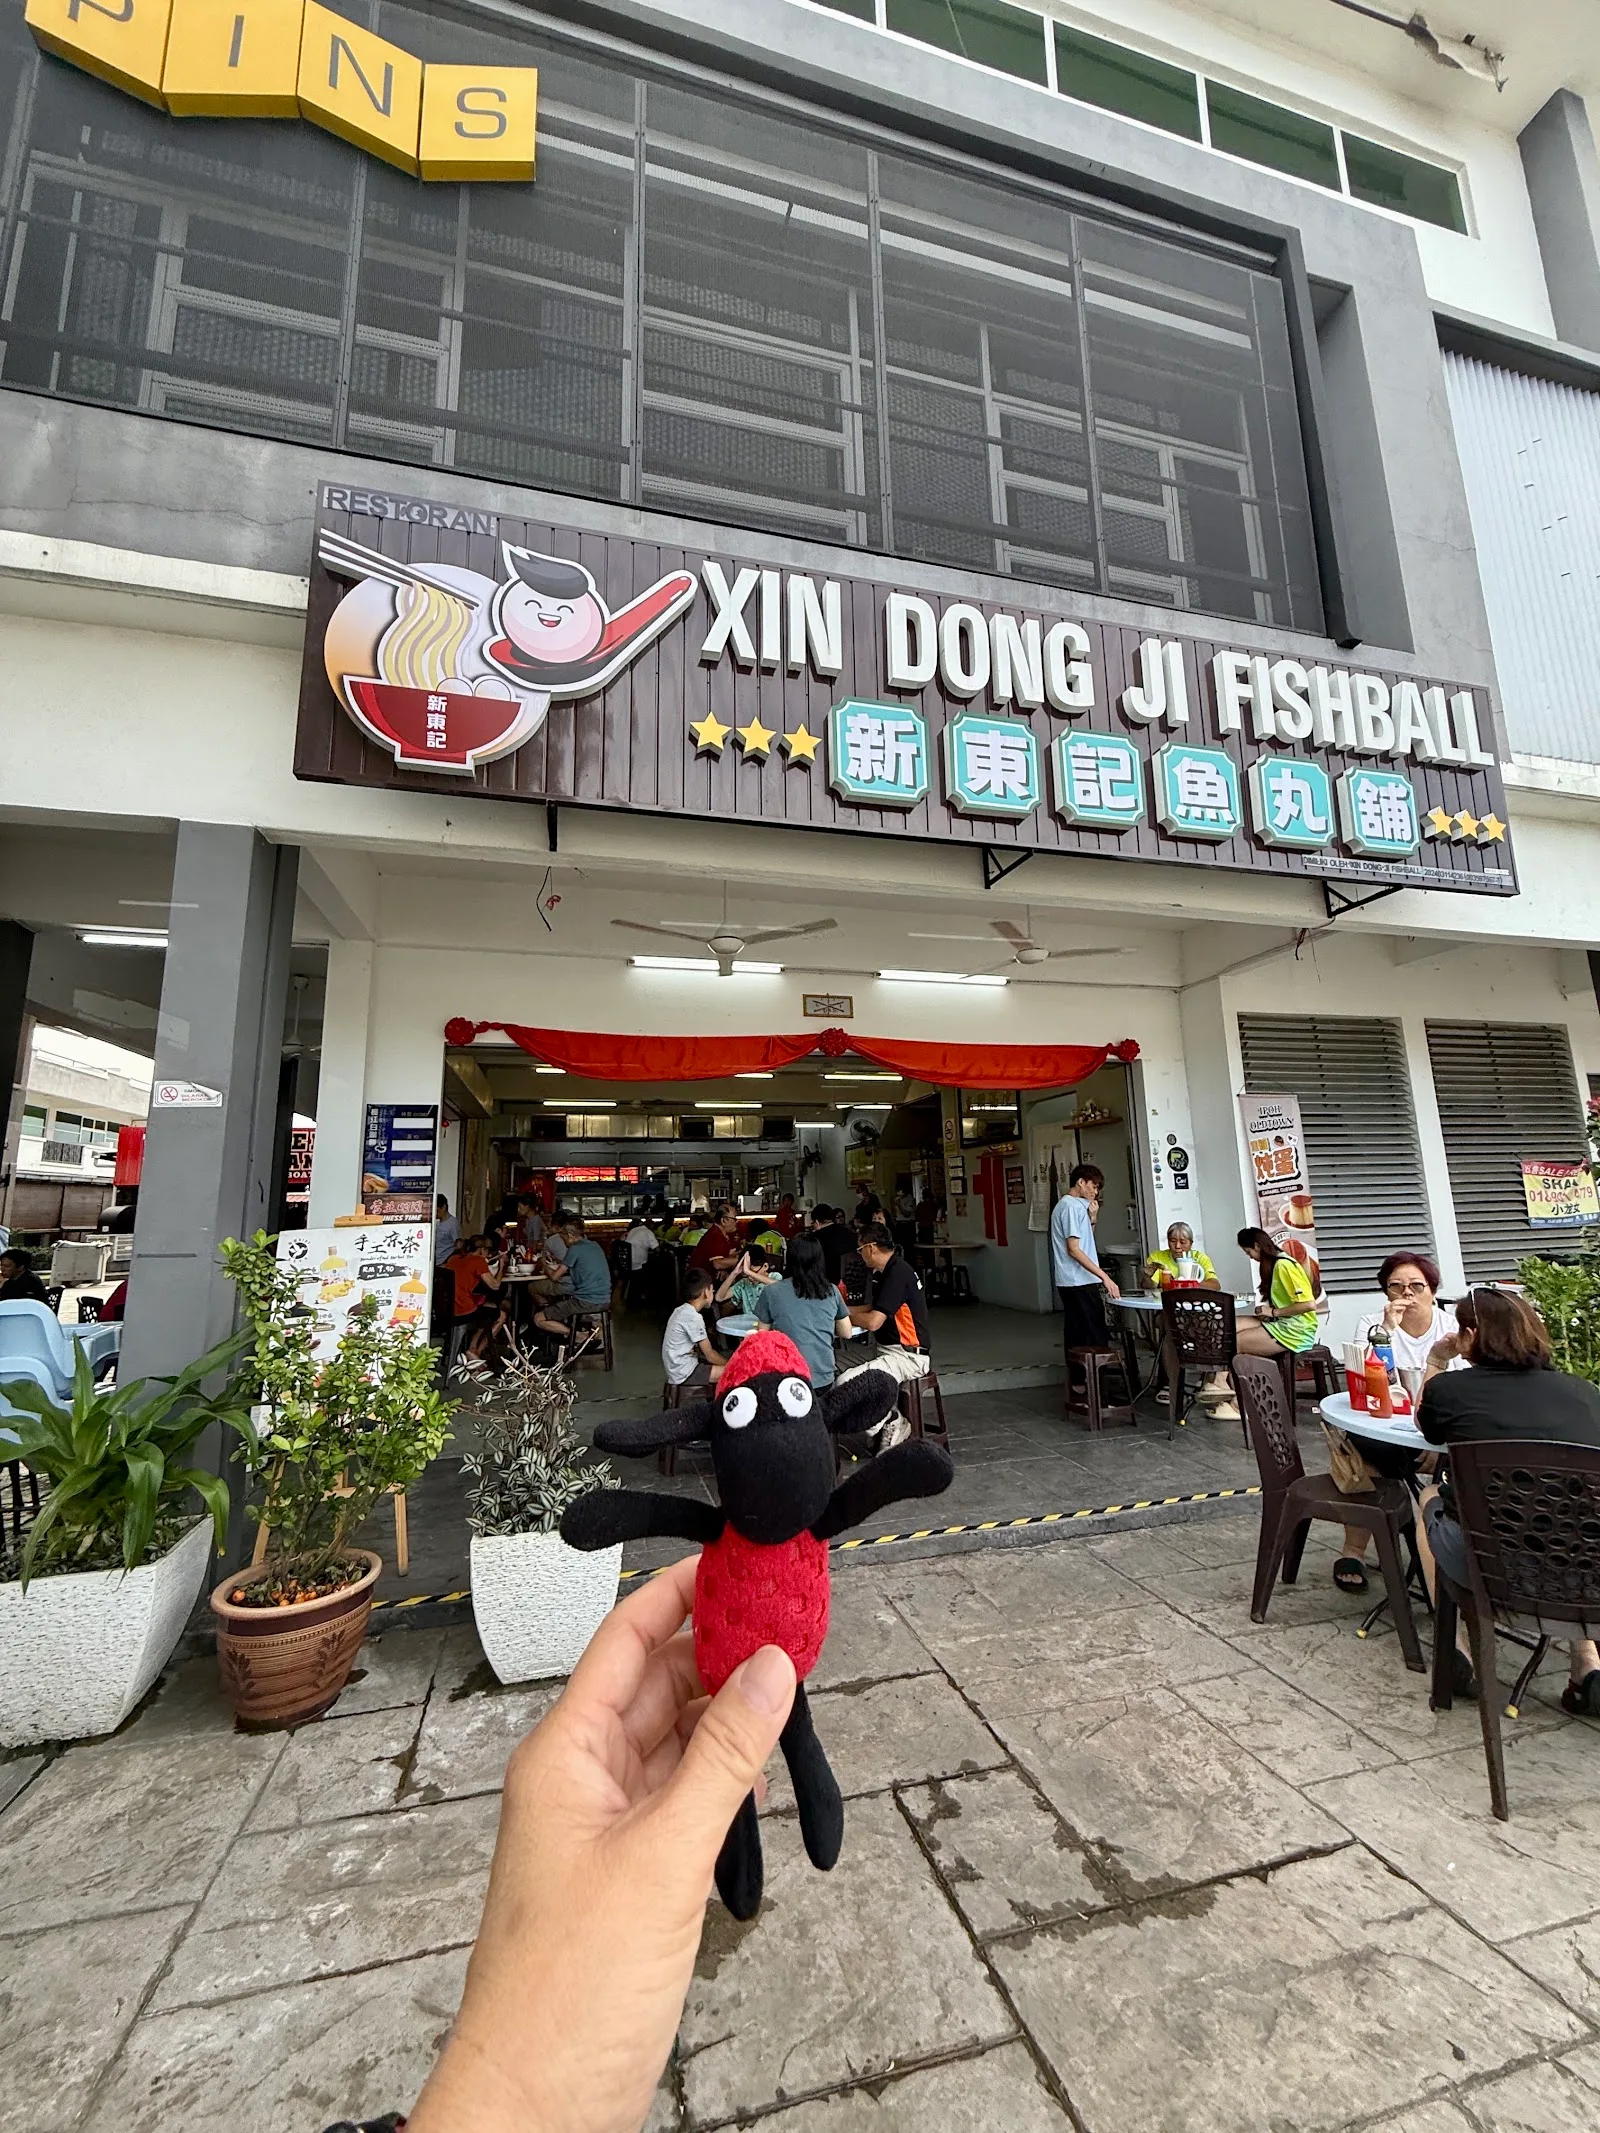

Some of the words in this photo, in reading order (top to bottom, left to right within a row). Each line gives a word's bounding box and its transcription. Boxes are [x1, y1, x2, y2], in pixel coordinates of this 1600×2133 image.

[327, 487, 492, 536] RESTORAN
[701, 560, 843, 678] XIN
[886, 592, 1095, 714] DONG
[1123, 638, 1189, 728] JI
[1213, 649, 1495, 771] FISHBALL
[426, 694, 448, 749] 新東記
[1363, 863, 1383, 872] DONG
[1391, 865, 1420, 875] FISHBALL
[1258, 1104, 1283, 1118] IPOH
[1250, 1118, 1294, 1133] OLDTOWN
[405, 1214, 423, 1222] TIME
